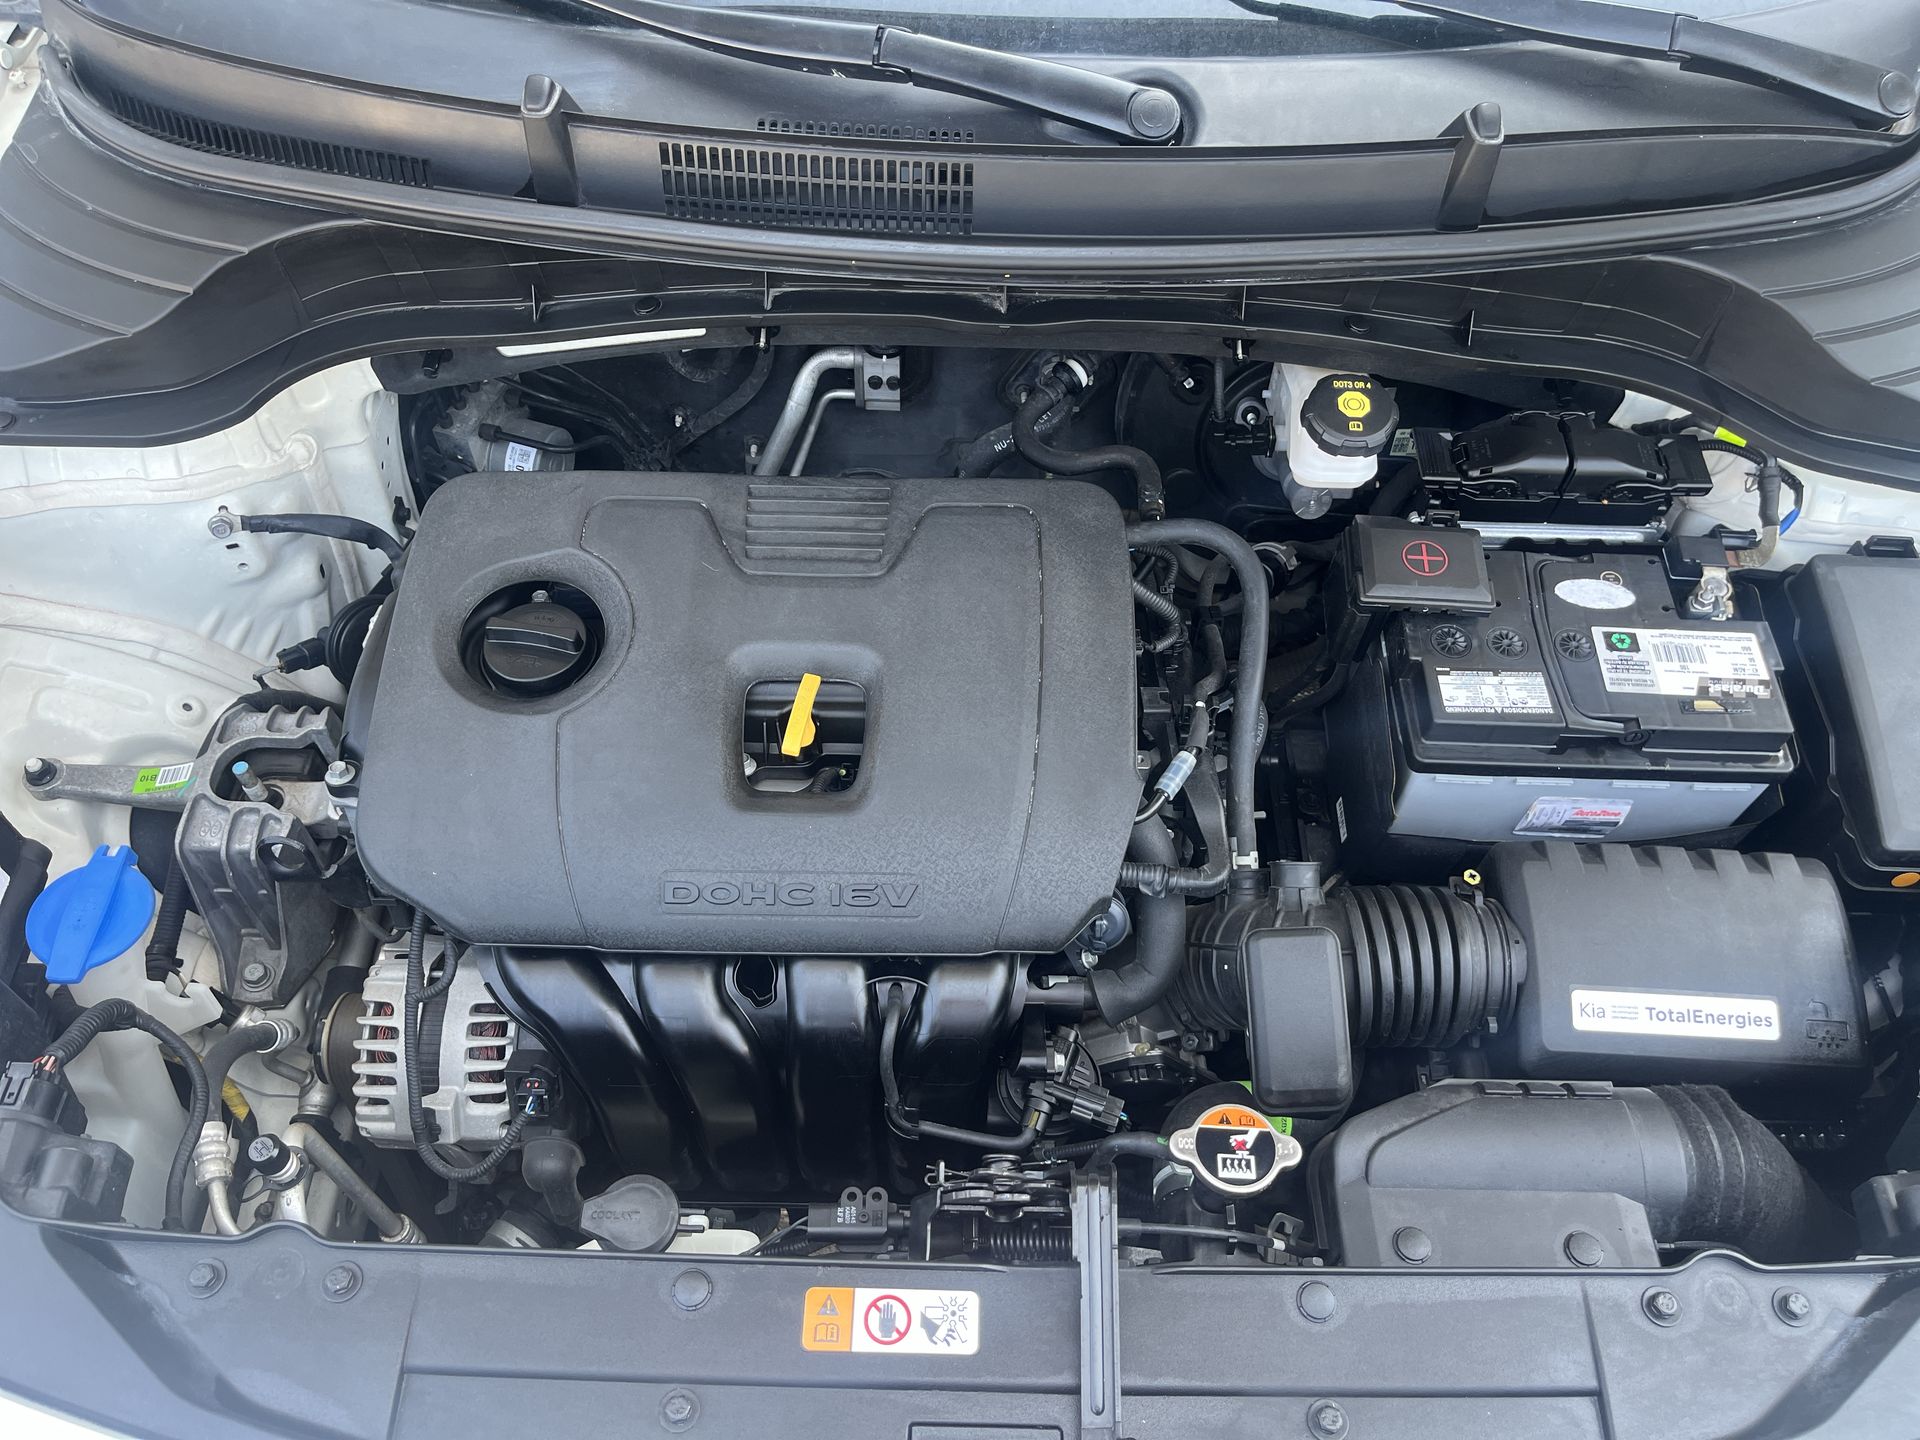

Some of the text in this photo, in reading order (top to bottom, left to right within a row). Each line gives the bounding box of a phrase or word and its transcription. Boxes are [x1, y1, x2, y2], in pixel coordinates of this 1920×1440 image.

[1354, 381, 1365, 389] OR
[1708, 683, 1769, 696] Duralast
[664, 881, 919, 908] DOHC 16V
[1580, 1003, 1606, 1019] Kia
[1645, 1006, 1773, 1029] TotalEnergies
